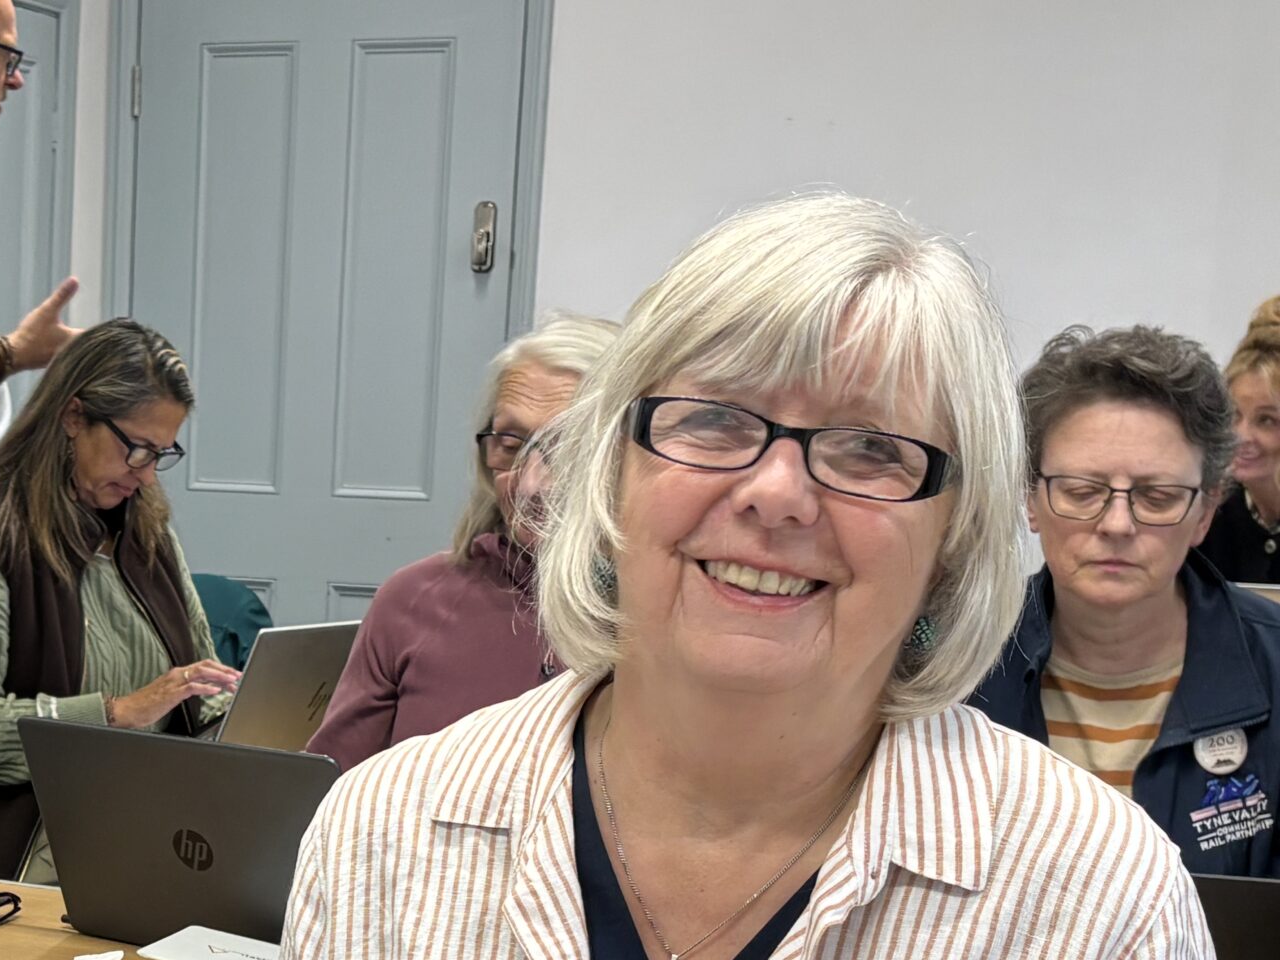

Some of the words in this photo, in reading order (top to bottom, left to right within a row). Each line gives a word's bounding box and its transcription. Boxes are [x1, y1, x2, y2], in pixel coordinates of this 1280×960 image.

[1209, 734, 1235, 748] 200
[178, 829, 211, 871] hp
[1200, 836, 1226, 852] RAIL
